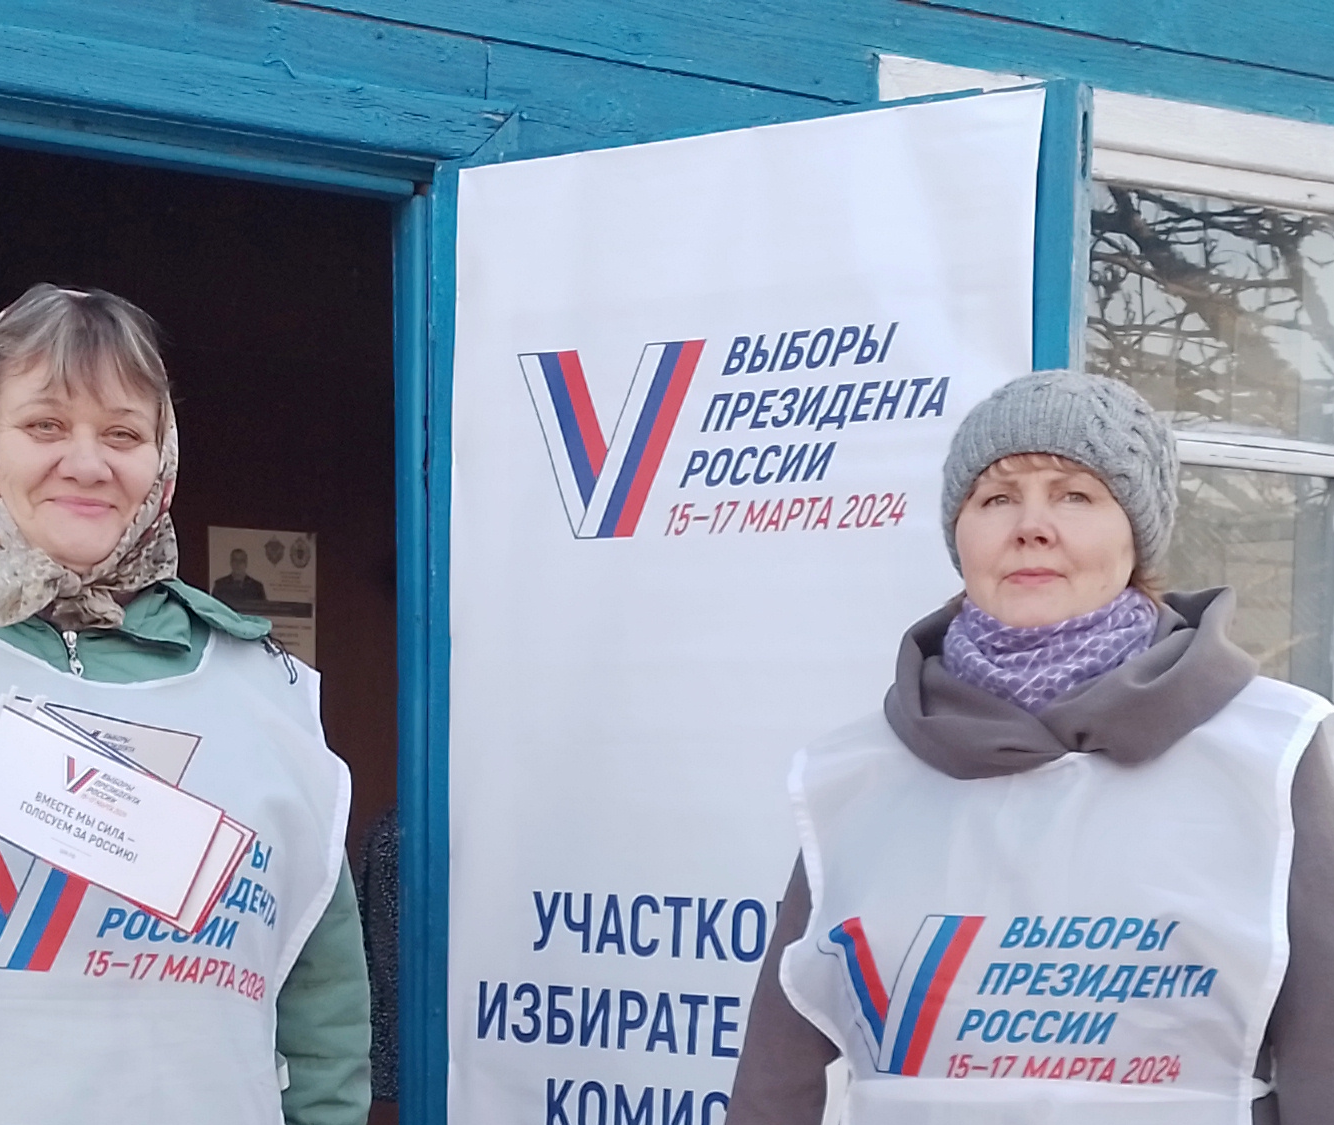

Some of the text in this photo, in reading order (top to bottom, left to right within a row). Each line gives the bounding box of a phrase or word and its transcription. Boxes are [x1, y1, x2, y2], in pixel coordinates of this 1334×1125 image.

[722, 321, 899, 377] ВЫБОРЫ
[700, 377, 951, 433] ПРЕЗИДЕНТА
[679, 441, 837, 488] РОССИИ
[741, 496, 834, 534] МАРТА
[836, 492, 907, 530] 2024
[20, 801, 138, 863] ГОЛОСУЕМ ЗА РОССИЮ!
[35, 792, 75, 818] ВМЕСТЕ
[76, 811, 95, 828] МЫ
[97, 821, 125, 842] СИЛА
[220, 876, 277, 930] ДЕНТА
[533, 891, 783, 962] УЧАСТКО
[1000, 916, 1181, 952] ВЫБОРЫ
[160, 954, 236, 990] МАРТА
[977, 964, 1218, 1003] ПРЕЗИДЕНТА
[477, 980, 741, 1059] ИЗБИРАТЕ
[956, 1008, 1118, 1045] РОССИИ
[1022, 1055, 1113, 1084] МАРТА
[1121, 1055, 1183, 1085] 2024
